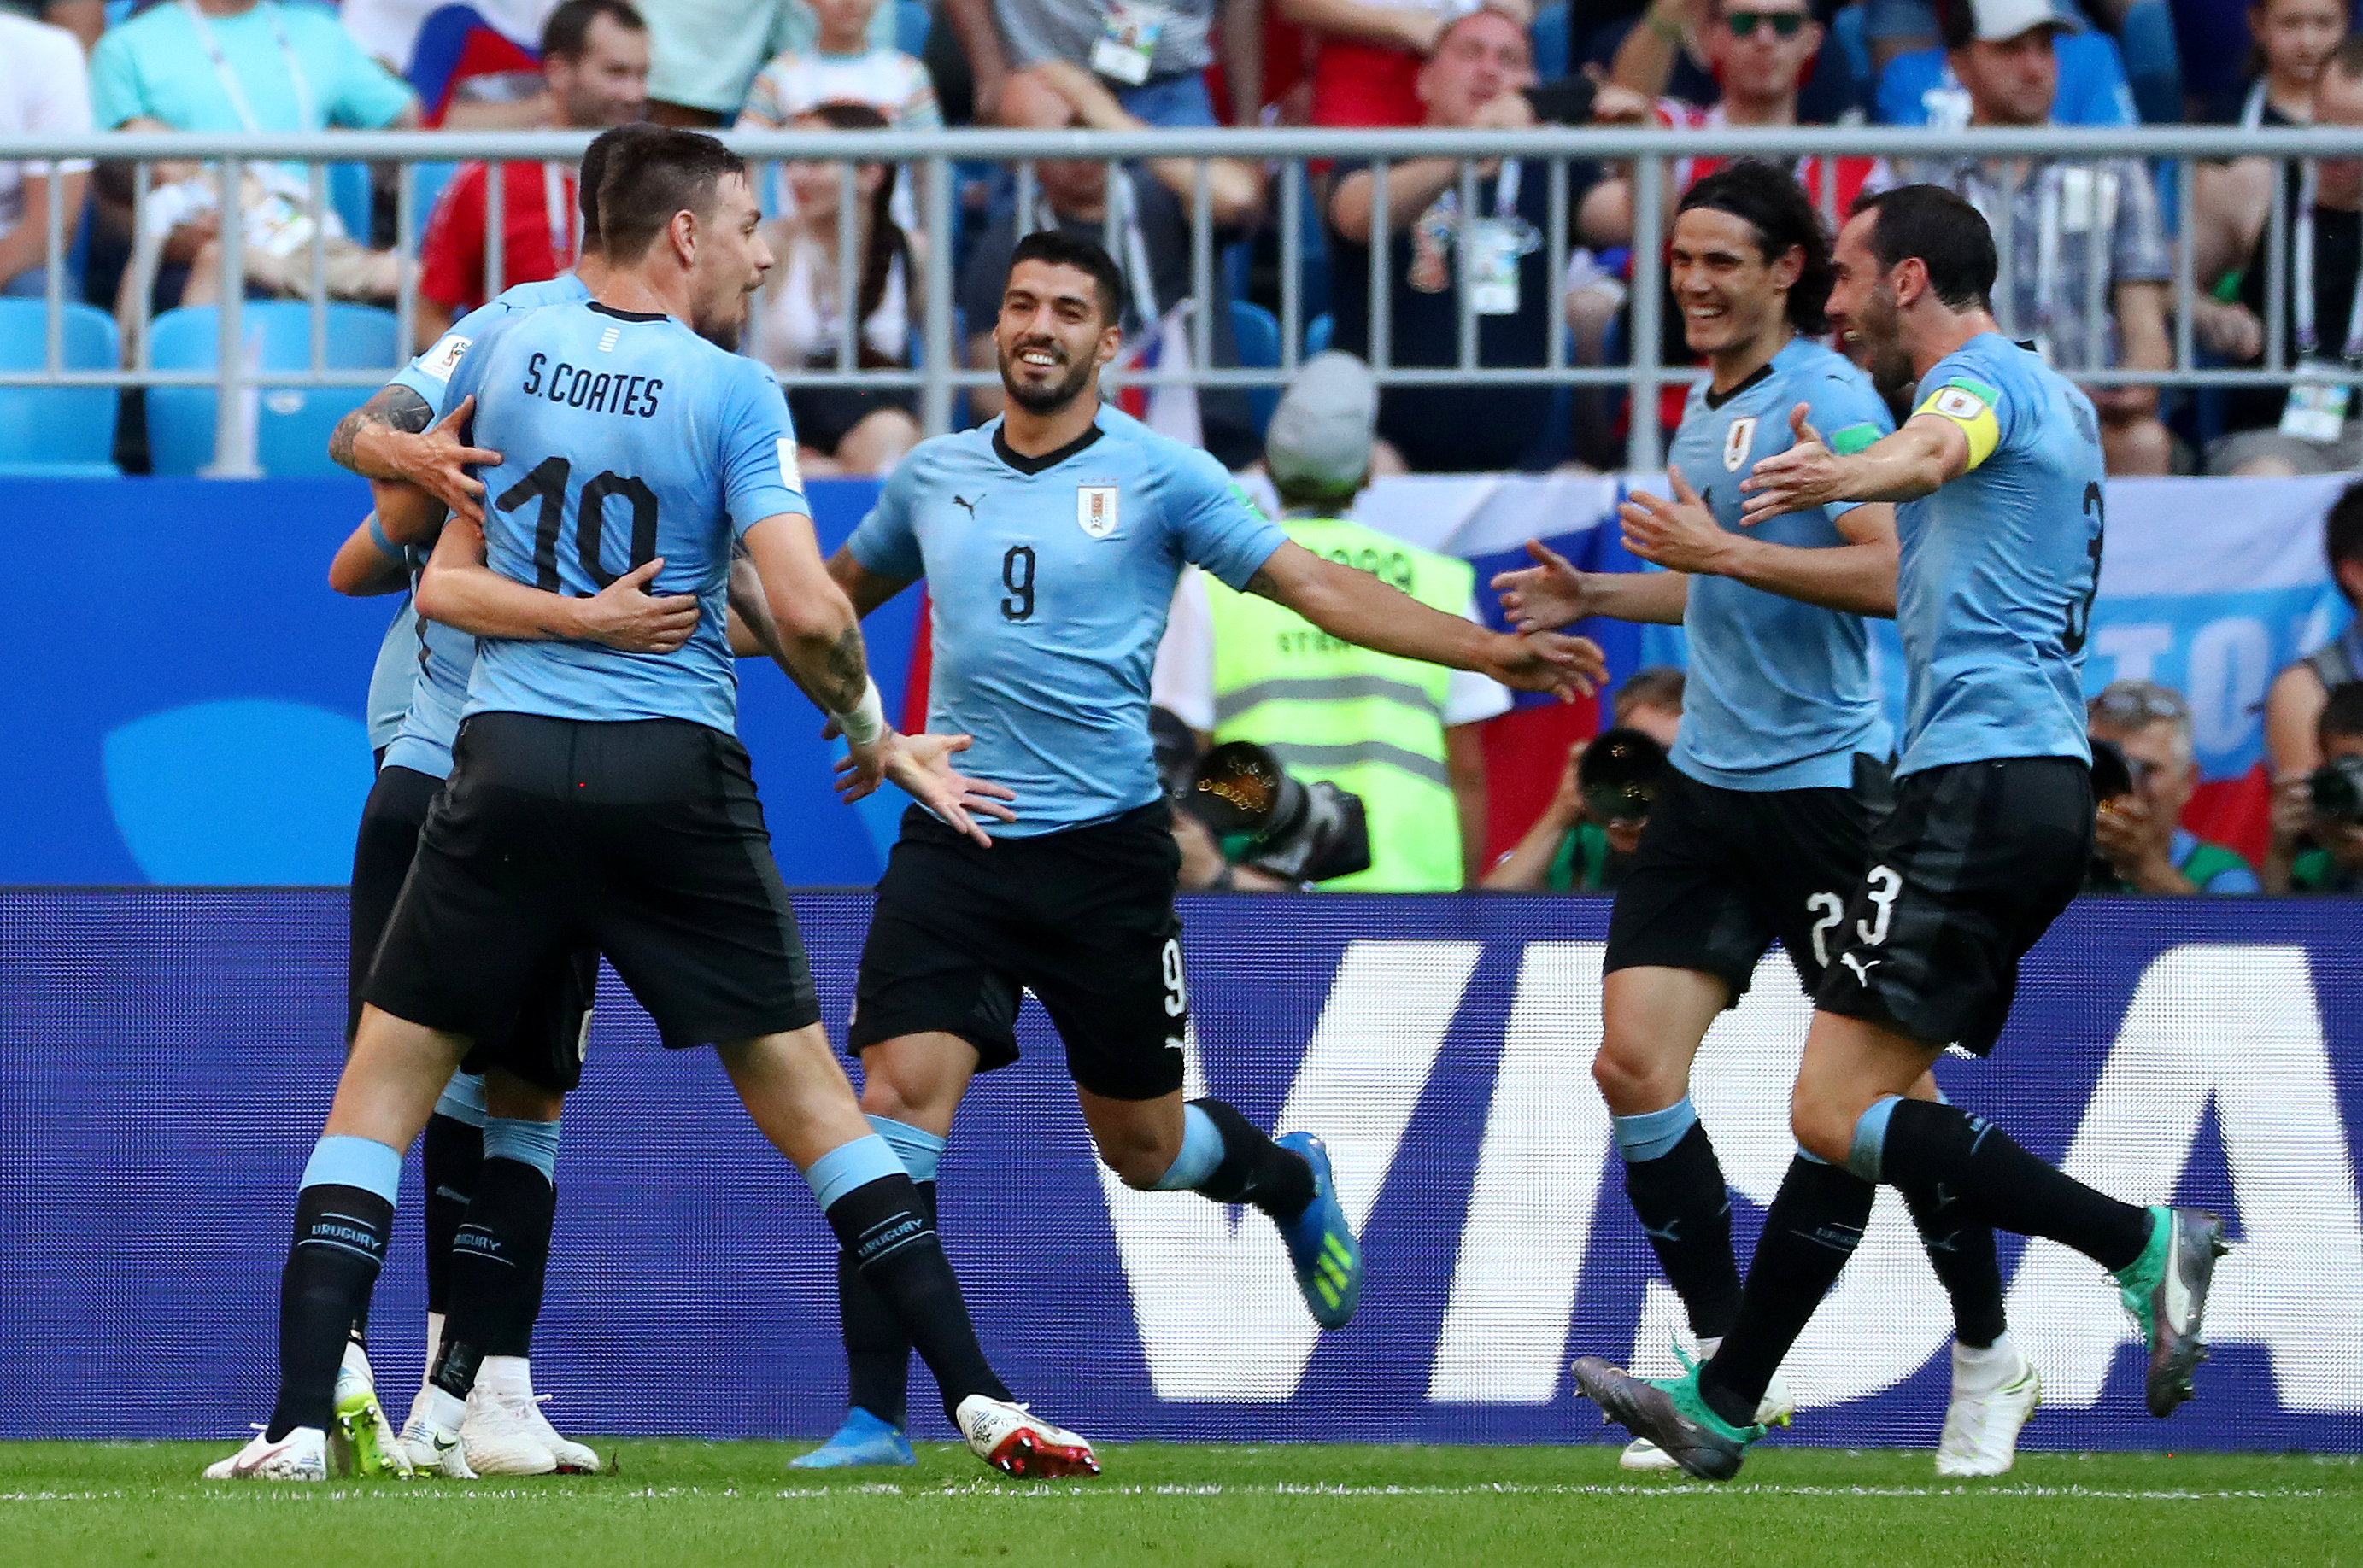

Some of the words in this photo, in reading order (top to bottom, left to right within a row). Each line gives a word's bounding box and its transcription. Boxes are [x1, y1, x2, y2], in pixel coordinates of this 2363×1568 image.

[523, 353, 663, 418] S.COATES
[495, 456, 658, 598] 10
[1001, 545, 1035, 622] 9
[2062, 481, 2105, 656] 3
[1806, 892, 1844, 968] 2
[1856, 864, 1903, 946] 3
[1162, 938, 1187, 1017] 9
[1022, 941, 2363, 1414] VISA
[311, 1223, 383, 1251] URUGUAY
[857, 1219, 923, 1257] URUGUAY
